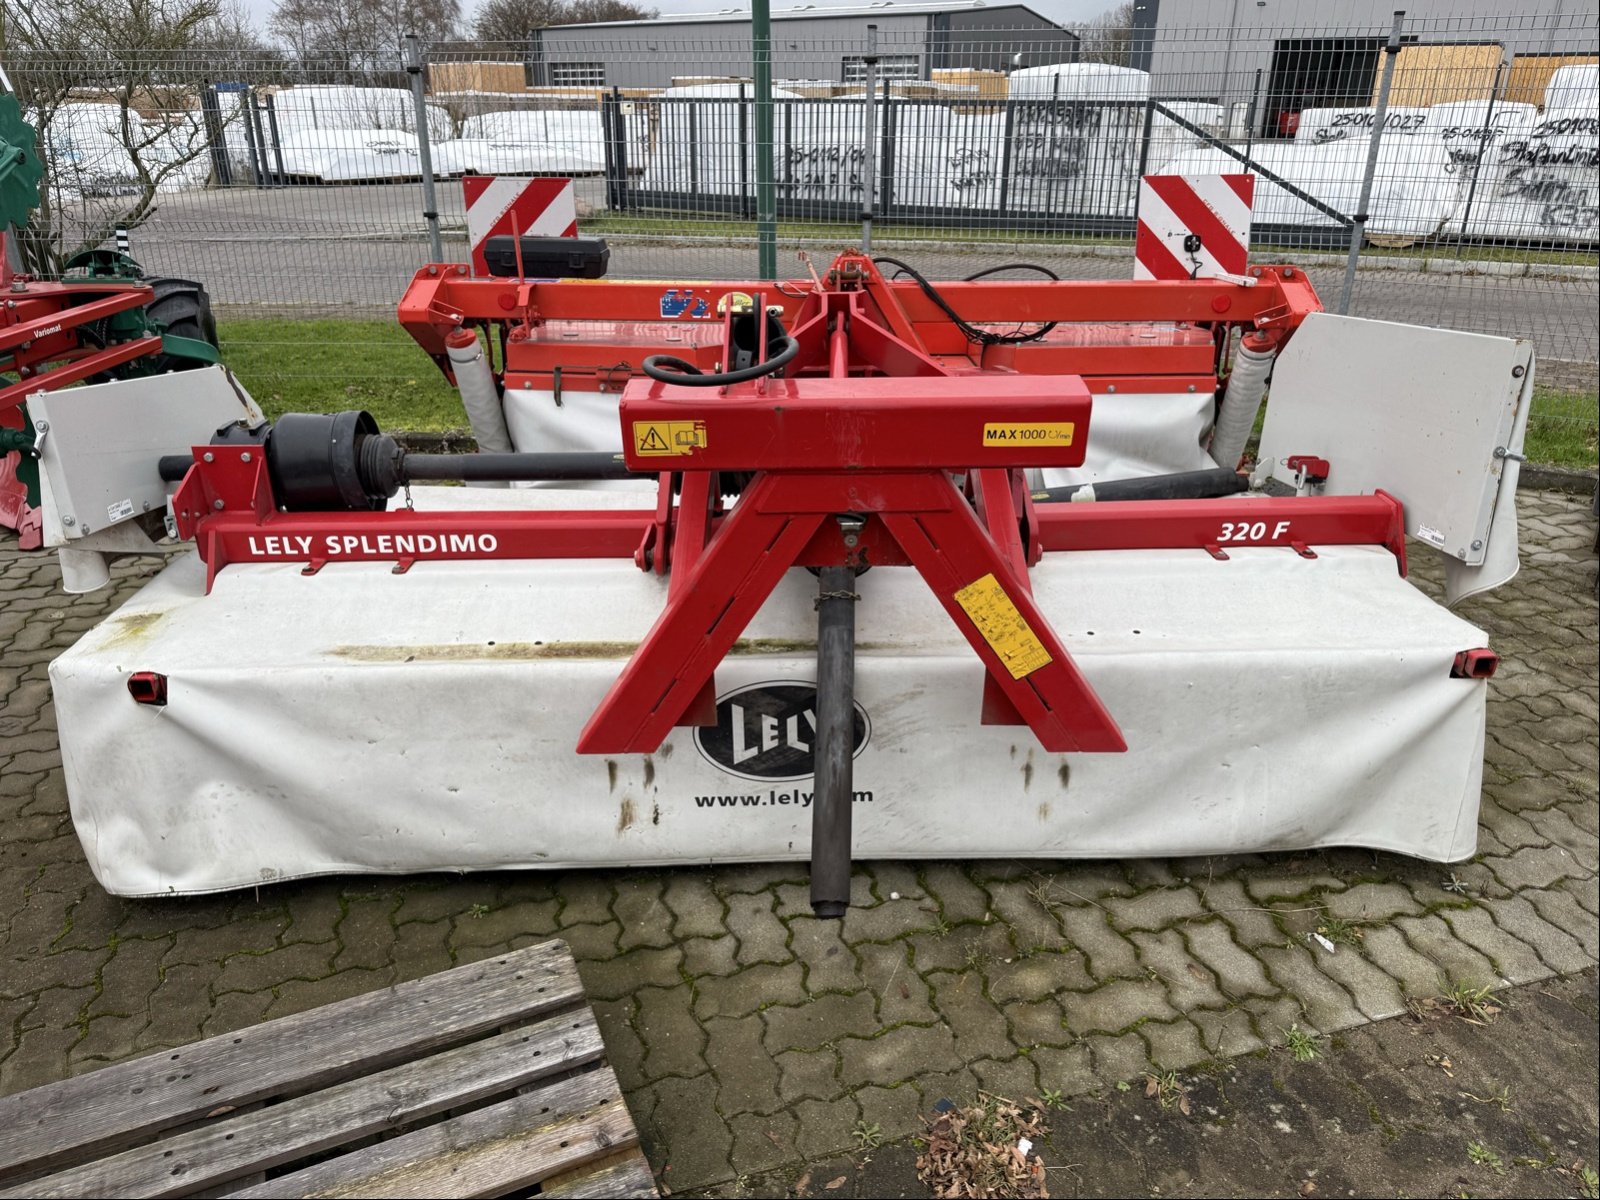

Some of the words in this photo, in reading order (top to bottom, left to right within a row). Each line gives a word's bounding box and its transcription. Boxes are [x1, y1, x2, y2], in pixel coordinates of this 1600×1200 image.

[33, 323, 62, 339] Variomat
[986, 429, 1017, 440] MAX
[1019, 429, 1047, 440] 1000
[1216, 522, 1266, 542] 320
[1272, 521, 1291, 540] F
[248, 536, 313, 556] LELY
[327, 533, 498, 555] SPLENDIMO
